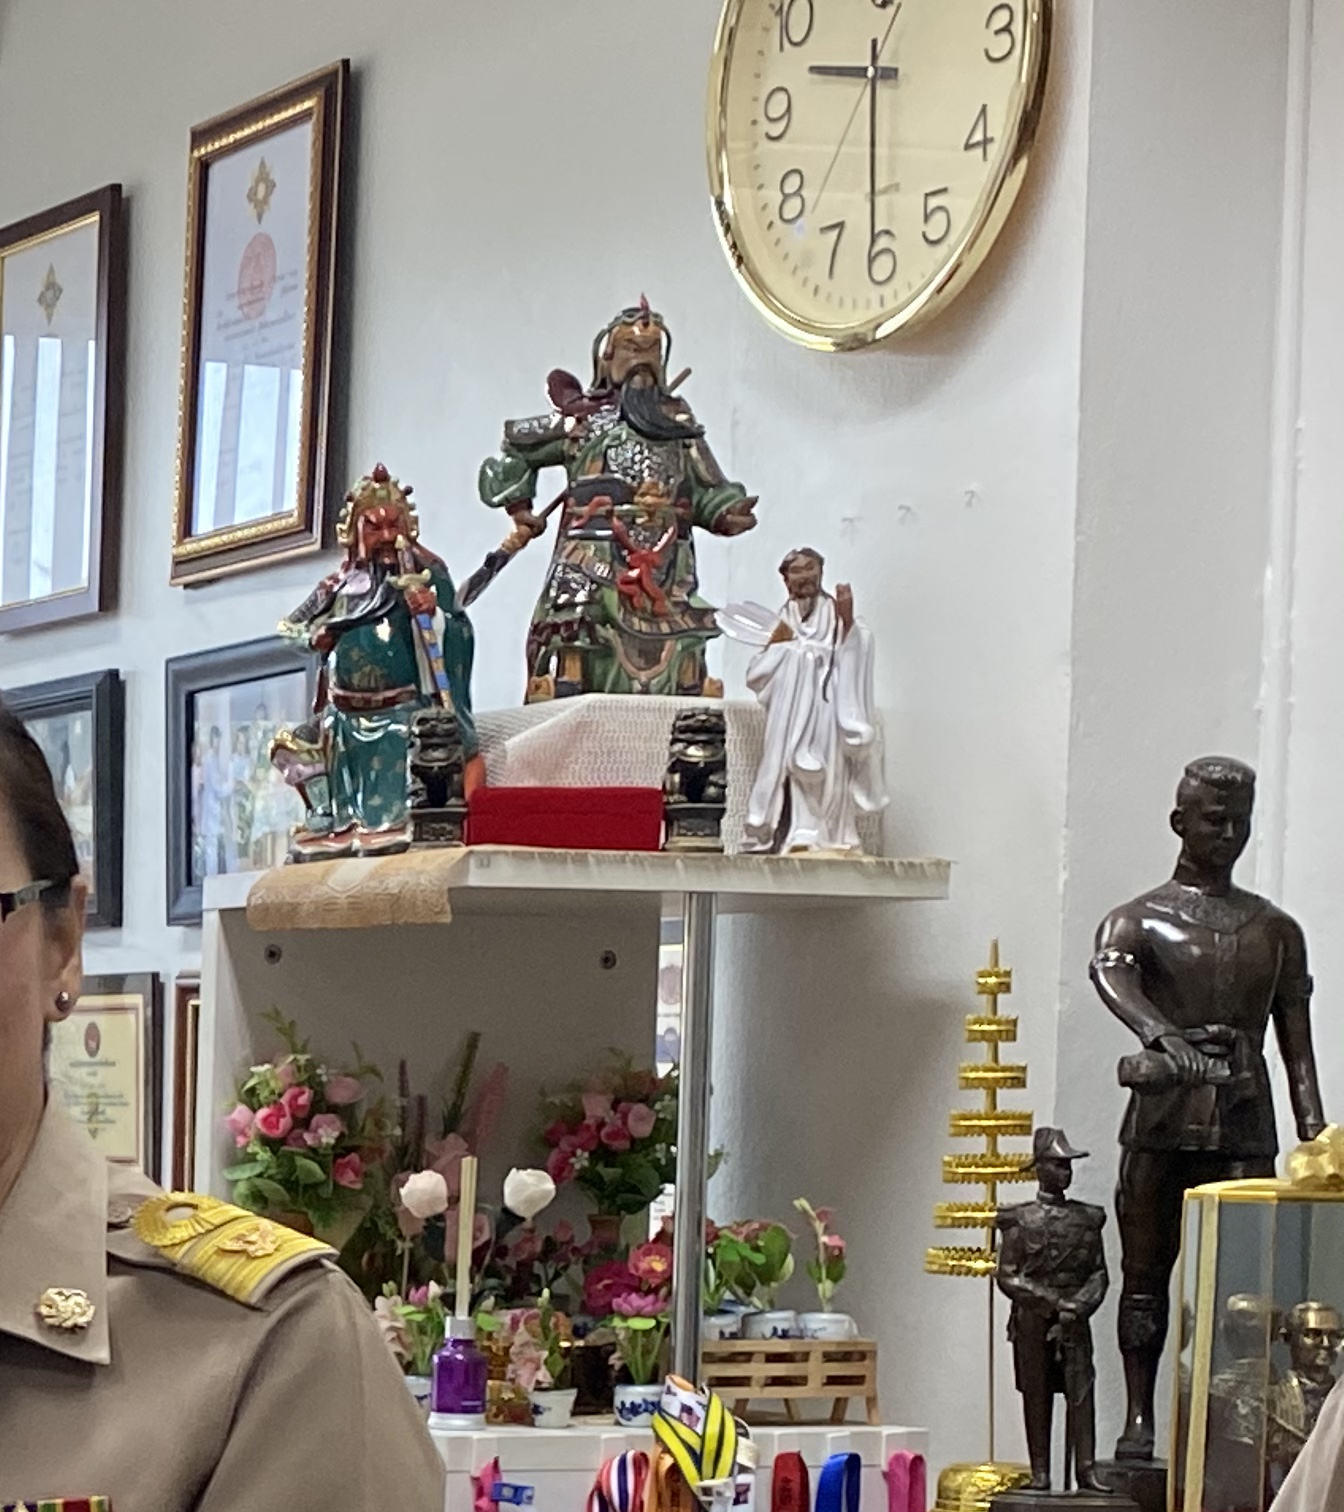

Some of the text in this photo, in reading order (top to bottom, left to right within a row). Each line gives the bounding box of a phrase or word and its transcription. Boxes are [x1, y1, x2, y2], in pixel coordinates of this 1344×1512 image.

[774, 0, 814, 52] 10
[983, 3, 1015, 63] 3
[764, 87, 792, 142] 9
[963, 103, 996, 162] 4
[778, 168, 805, 224] 8
[922, 187, 952, 246] 5
[819, 220, 846, 280] 7
[867, 229, 897, 286] 6
